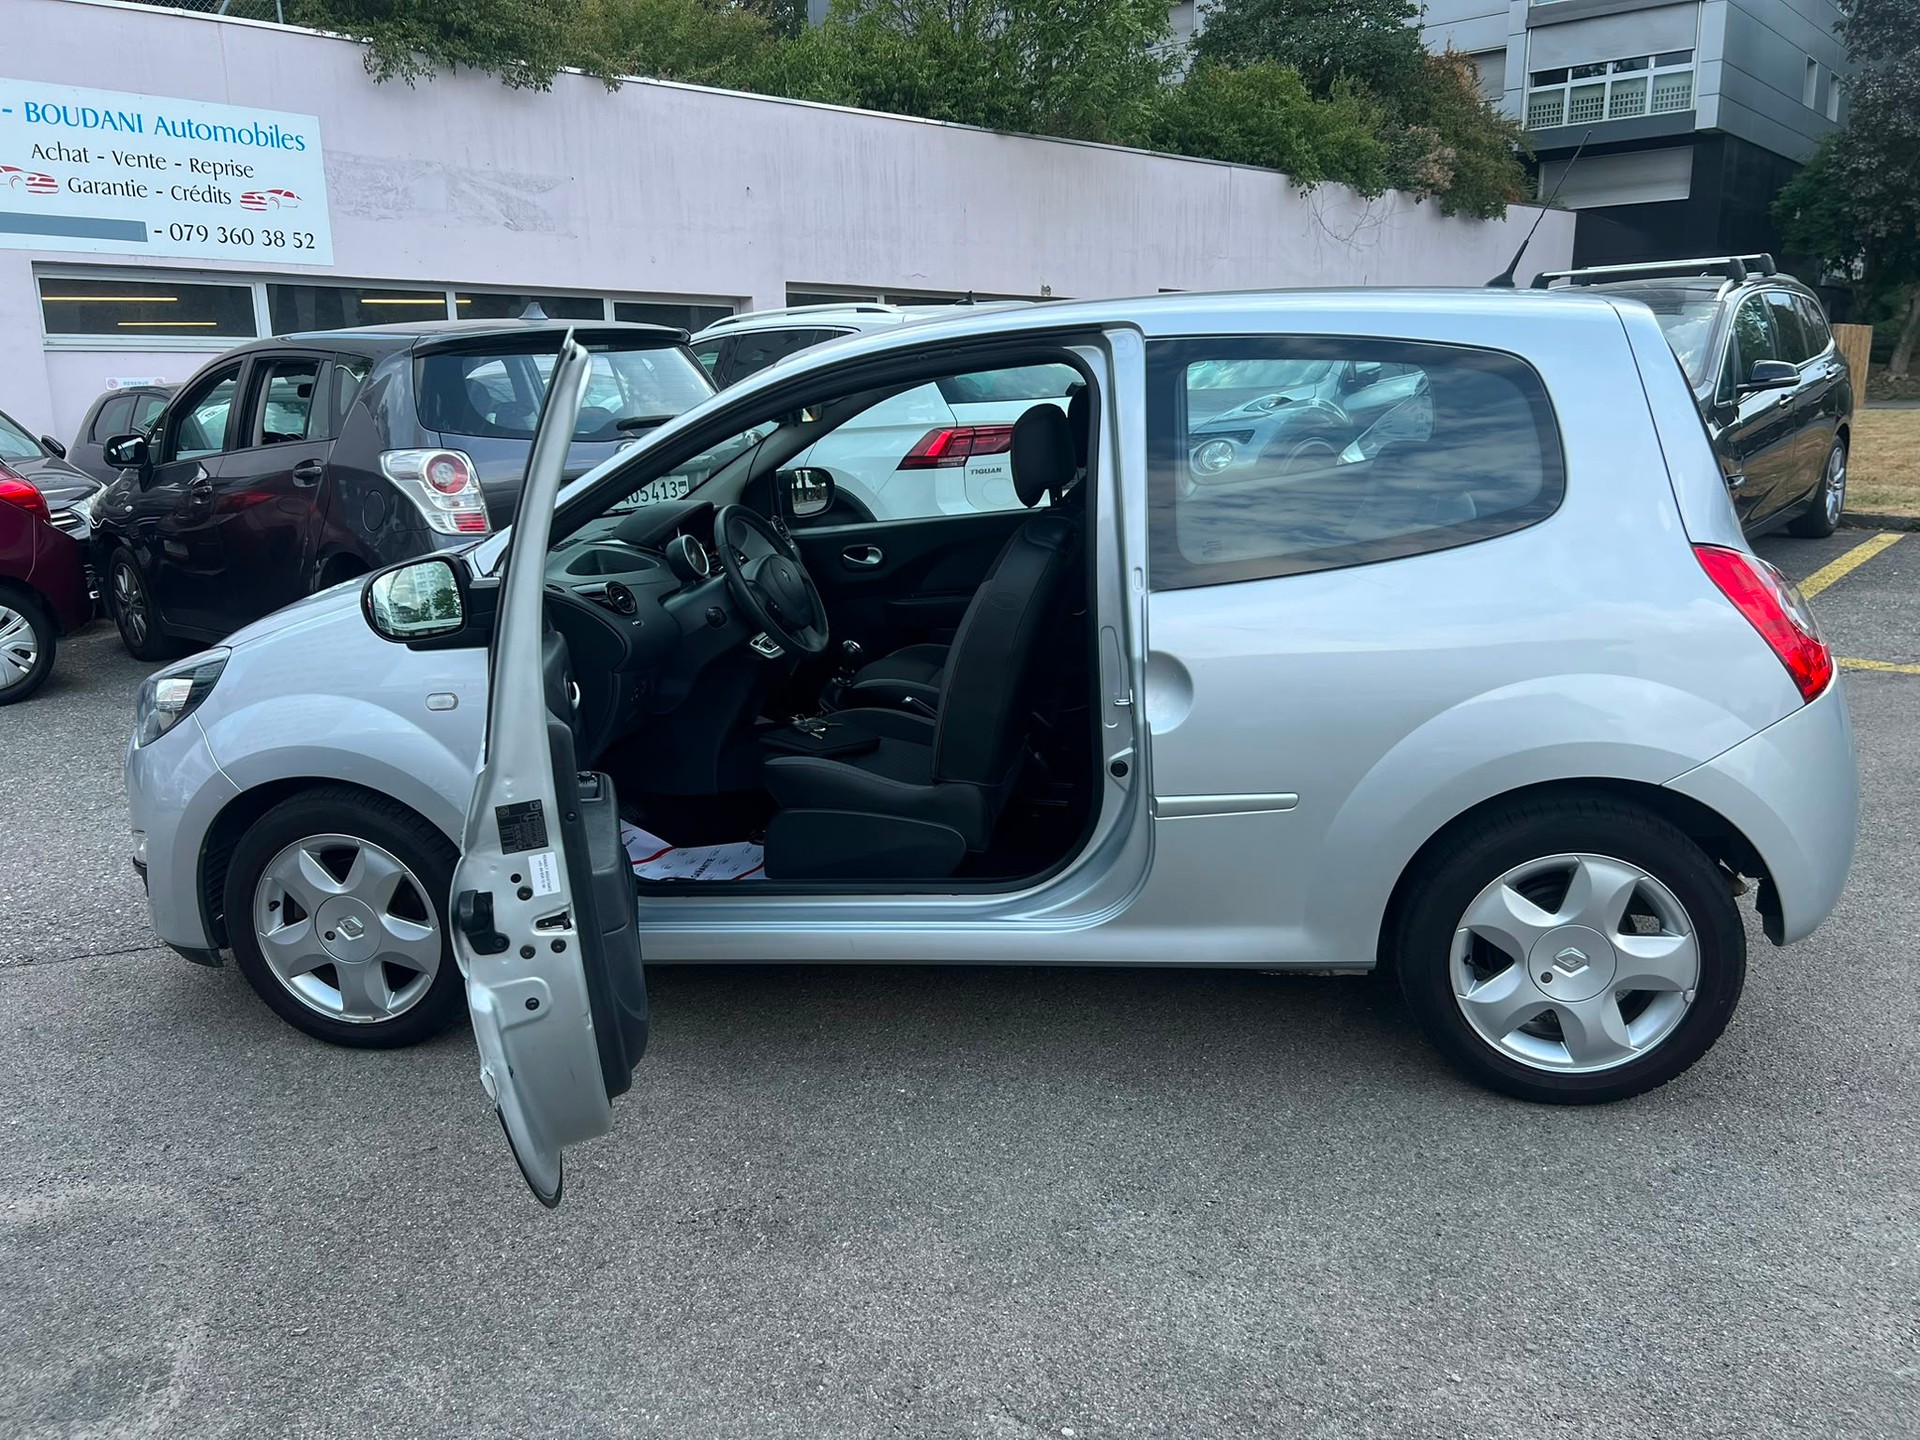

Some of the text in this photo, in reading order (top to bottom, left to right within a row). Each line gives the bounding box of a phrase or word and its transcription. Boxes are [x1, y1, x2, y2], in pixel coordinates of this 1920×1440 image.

[24, 101, 143, 133] BOUDANI
[154, 116, 305, 151] Automobiles
[31, 141, 90, 163] Achat
[111, 150, 167, 170] Vente
[189, 157, 254, 181] Reprise
[67, 177, 148, 198] Garantie
[170, 184, 232, 205] Crédits
[169, 223, 208, 242] 079
[217, 226, 254, 246] 360
[261, 230, 286, 247] 38
[293, 232, 315, 249] 52
[970, 467, 1002, 475] TIGUAN
